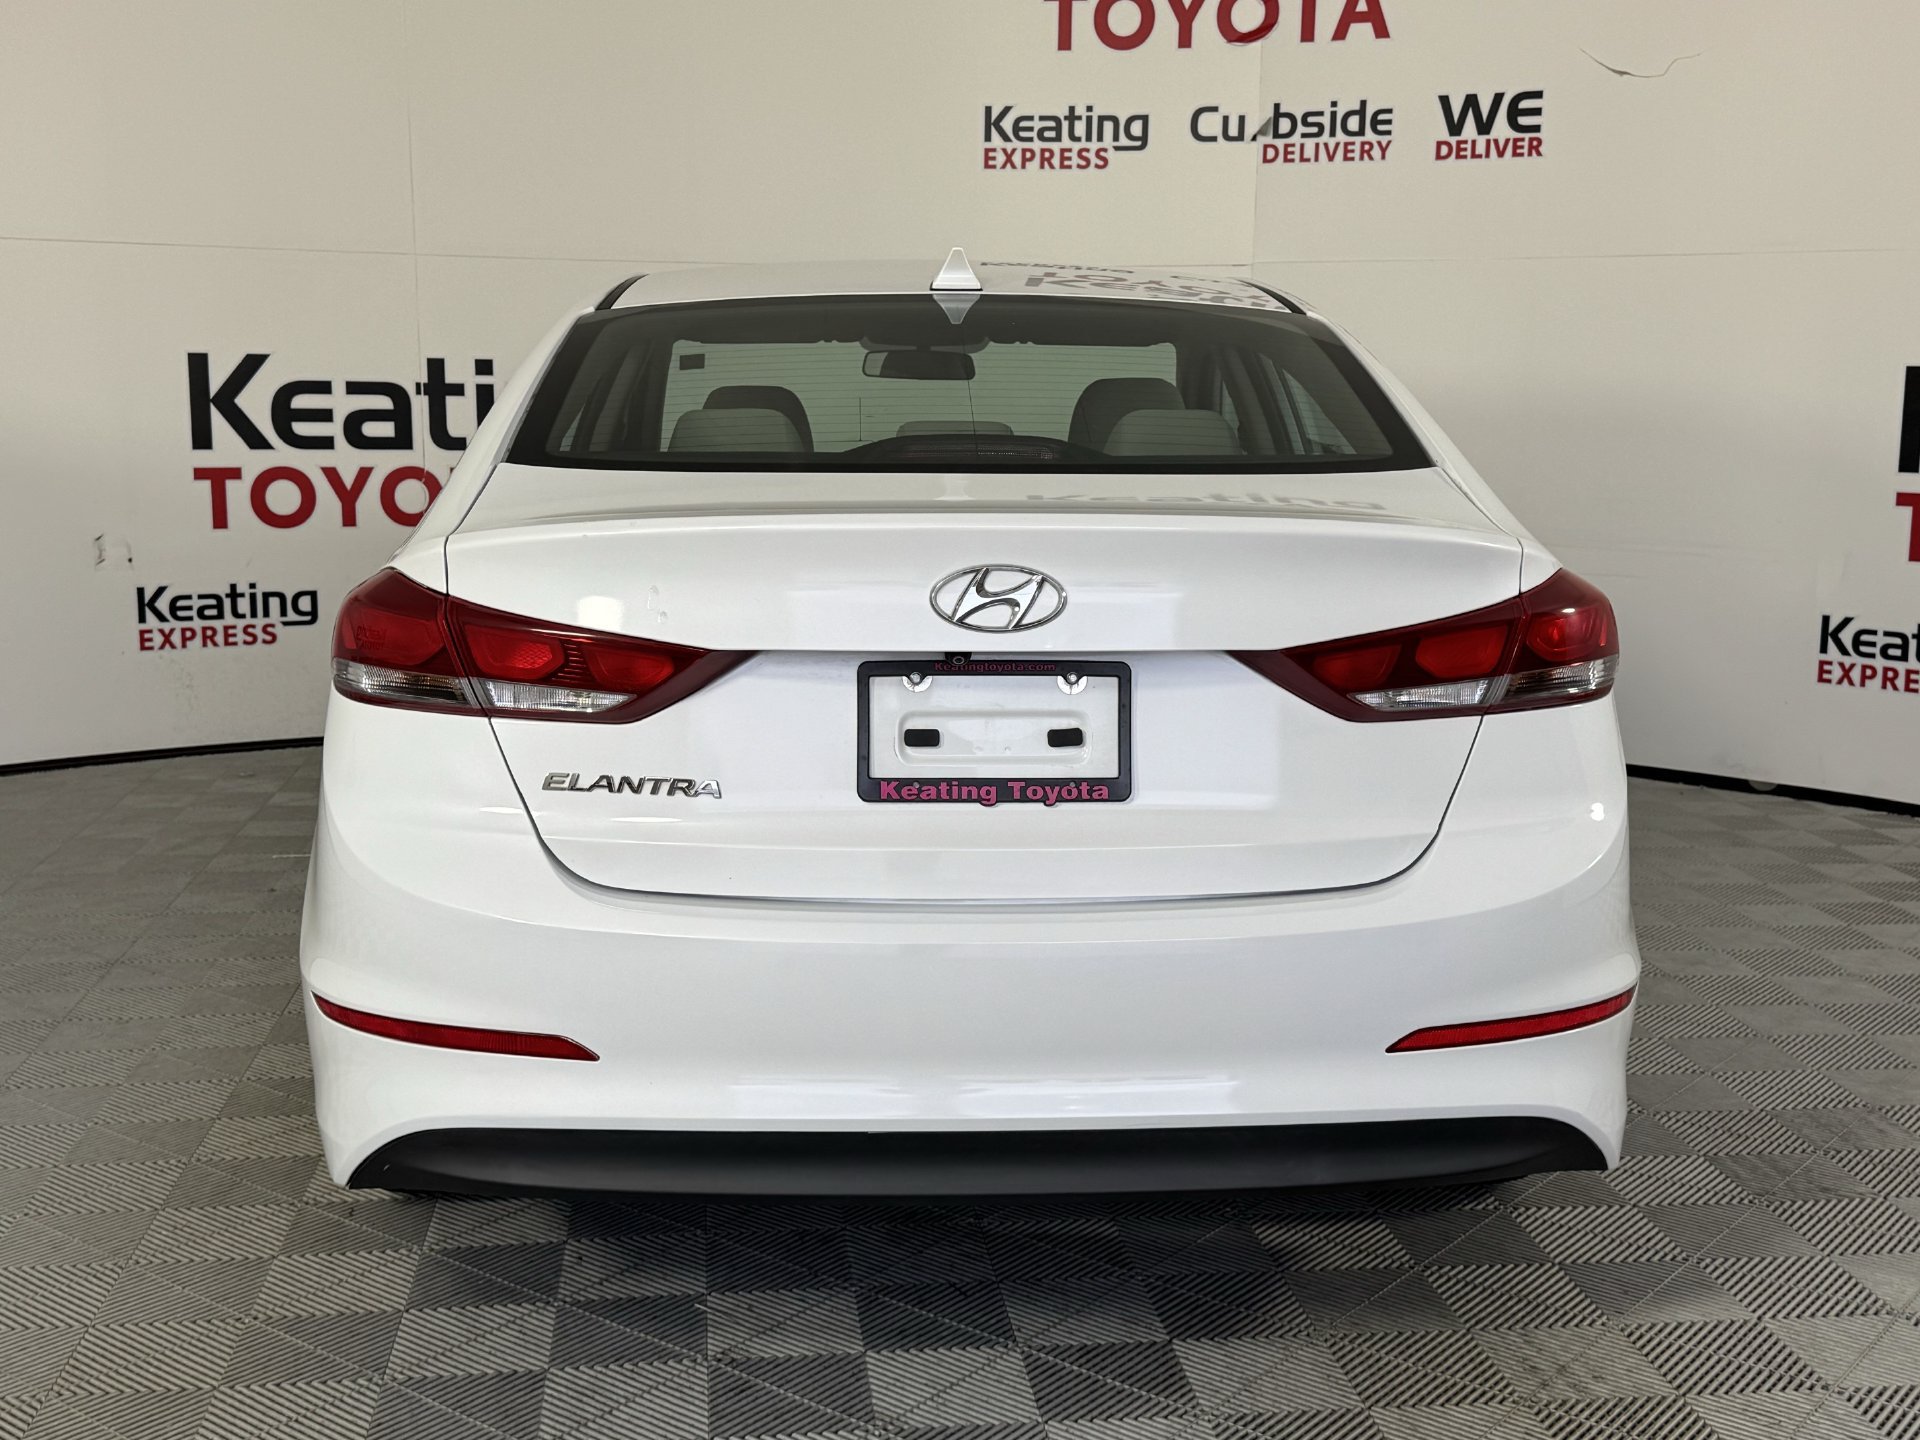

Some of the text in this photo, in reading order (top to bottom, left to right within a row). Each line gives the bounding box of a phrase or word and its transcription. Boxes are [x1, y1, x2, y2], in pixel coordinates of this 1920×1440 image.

[984, 99, 1394, 151] Keating Cubside
[1437, 90, 1544, 137] WE
[983, 147, 1109, 169] EXPRESS
[1262, 140, 1392, 163] DELIVERY
[1435, 136, 1543, 161] DELIVER
[193, 466, 455, 529] TOYO
[136, 583, 318, 626] Keating
[138, 624, 277, 651] EXPRESS
[542, 772, 722, 799] ELANTRA
[879, 780, 1110, 805] Keating Toyota
